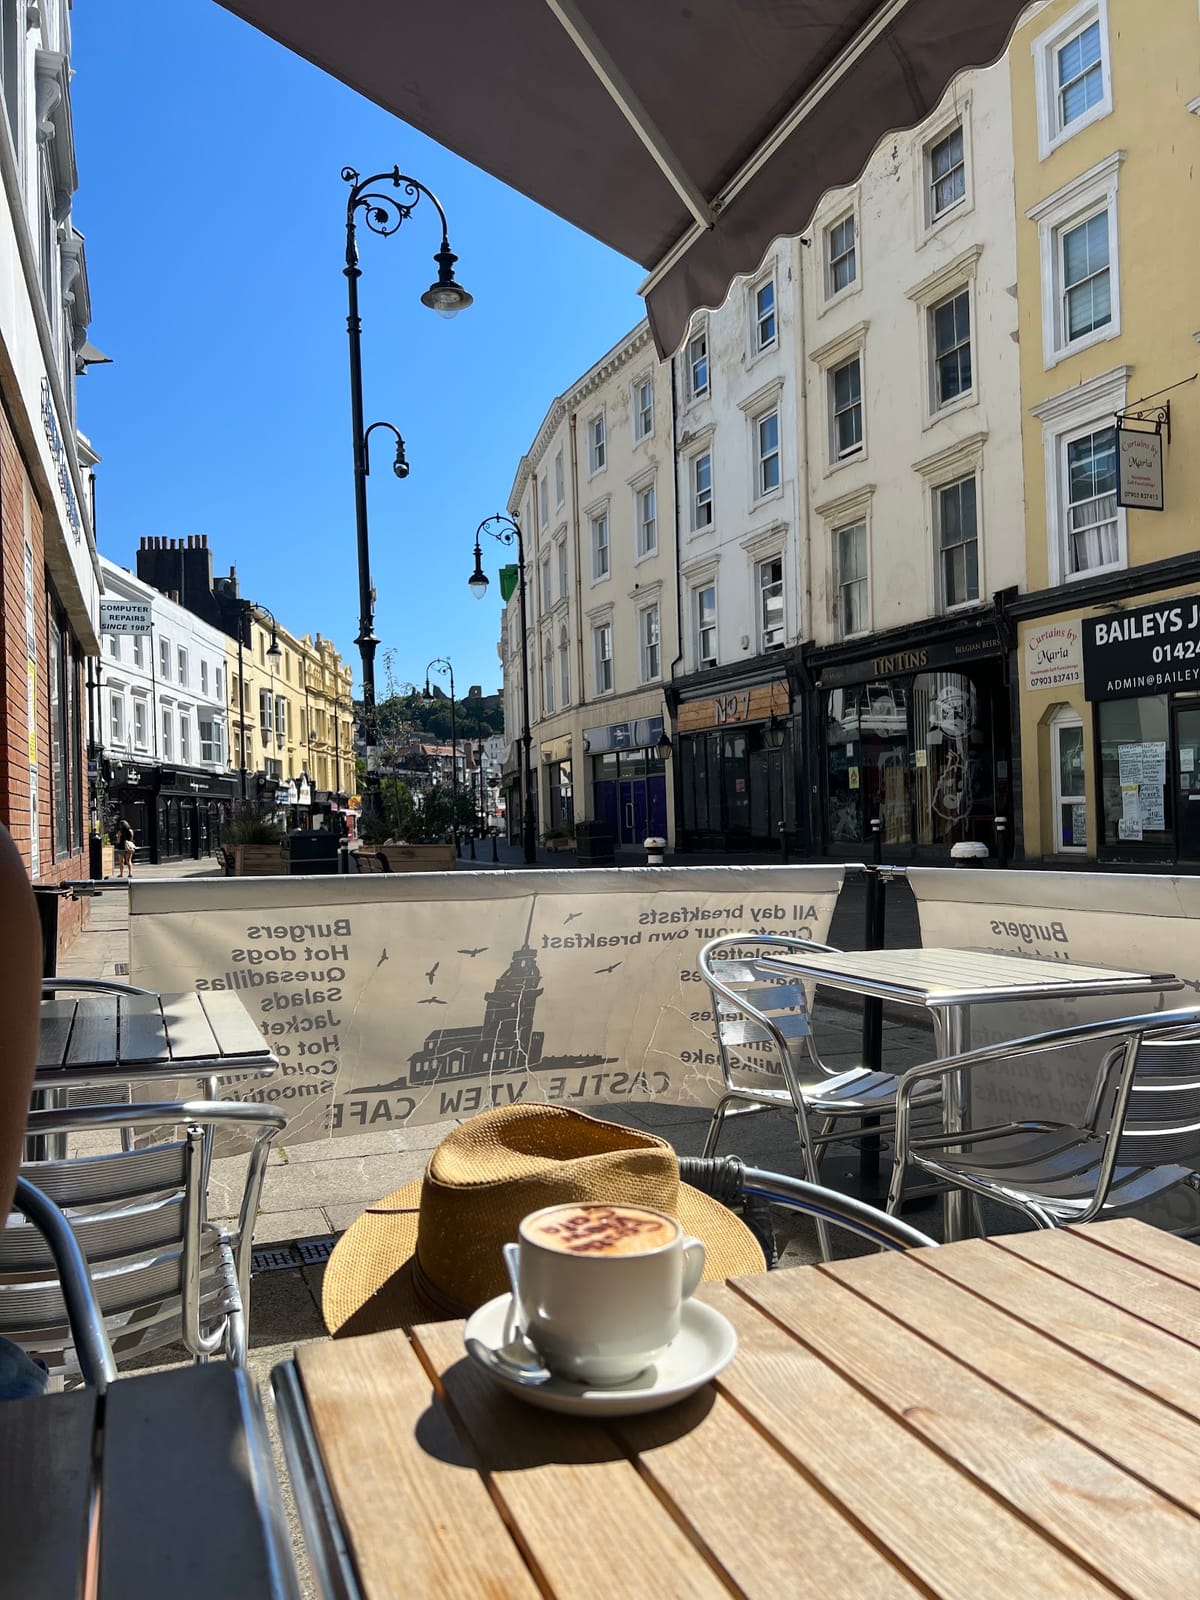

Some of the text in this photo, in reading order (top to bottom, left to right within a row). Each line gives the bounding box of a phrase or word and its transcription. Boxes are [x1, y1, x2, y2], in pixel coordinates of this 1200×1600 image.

[1128, 456, 1153, 469] Maria
[100, 604, 149, 613] COMPUTER
[109, 614, 146, 622] REPAIRS
[100, 623, 151, 632] SINCE 1987
[1095, 607, 1183, 646] BAILEYS
[1029, 627, 1078, 651] Curtains by
[1037, 647, 1069, 664] Maria
[1030, 672, 1080, 687] 07903 837413
